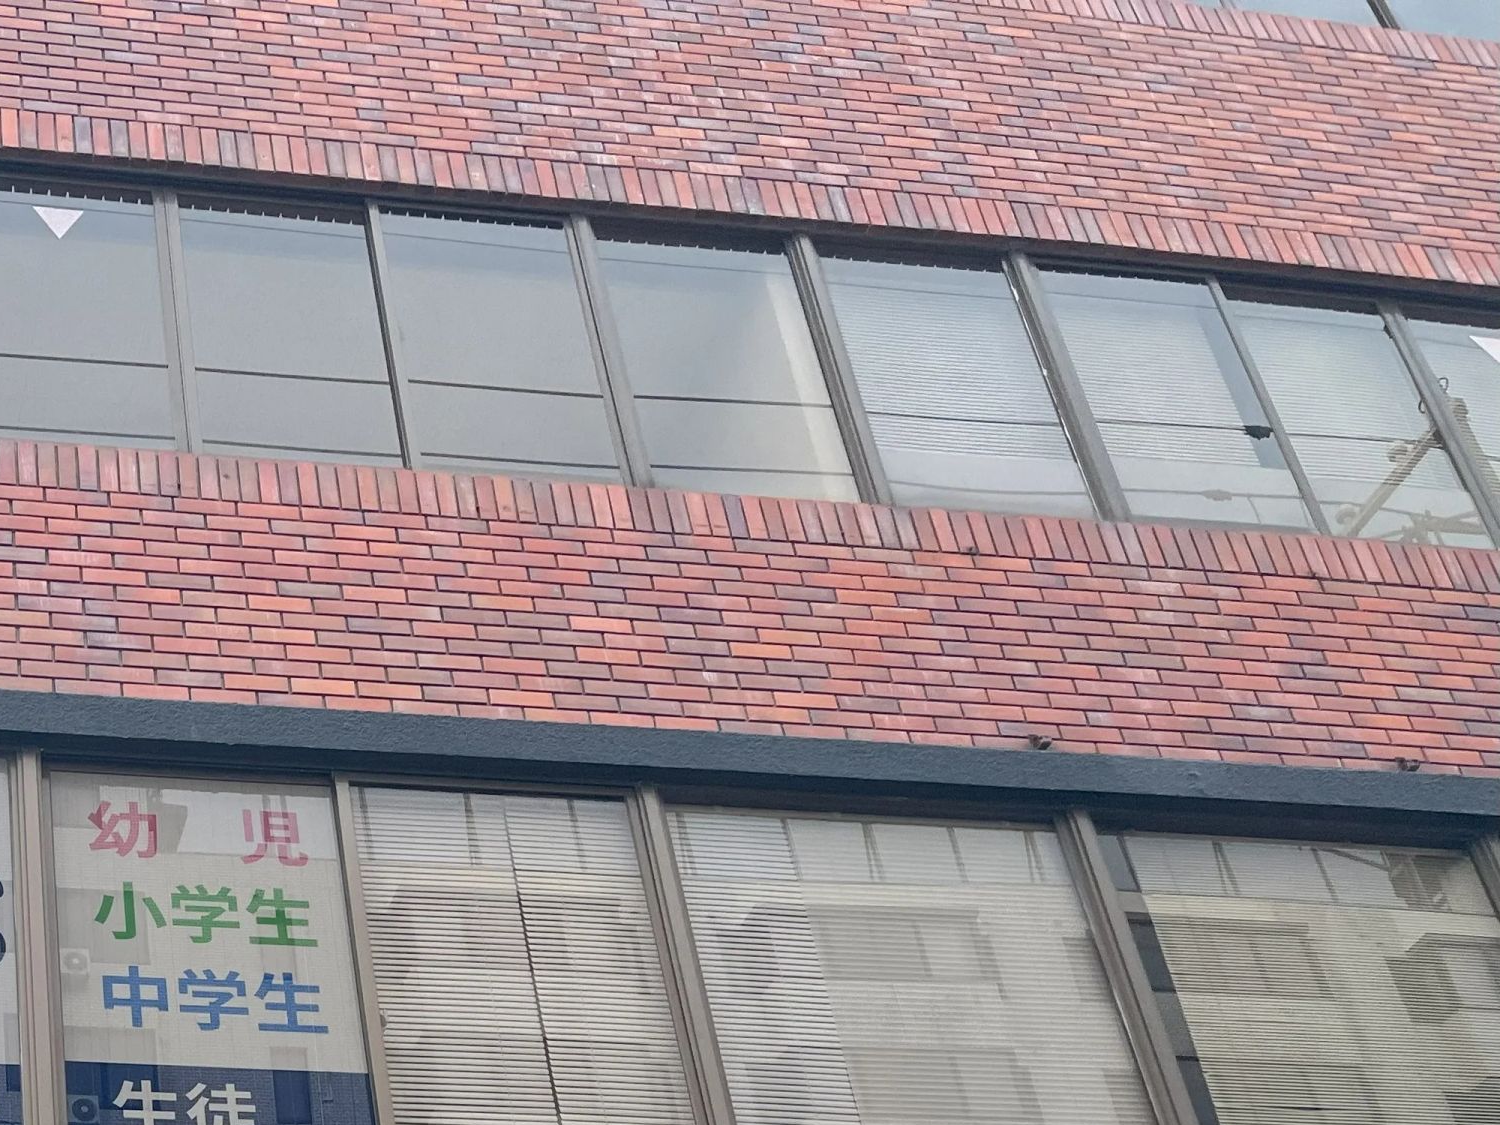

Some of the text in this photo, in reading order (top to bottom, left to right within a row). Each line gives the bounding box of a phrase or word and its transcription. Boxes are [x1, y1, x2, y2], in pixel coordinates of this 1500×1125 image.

[94, 881, 318, 947] 小学生
[102, 965, 329, 1034] 中学生
